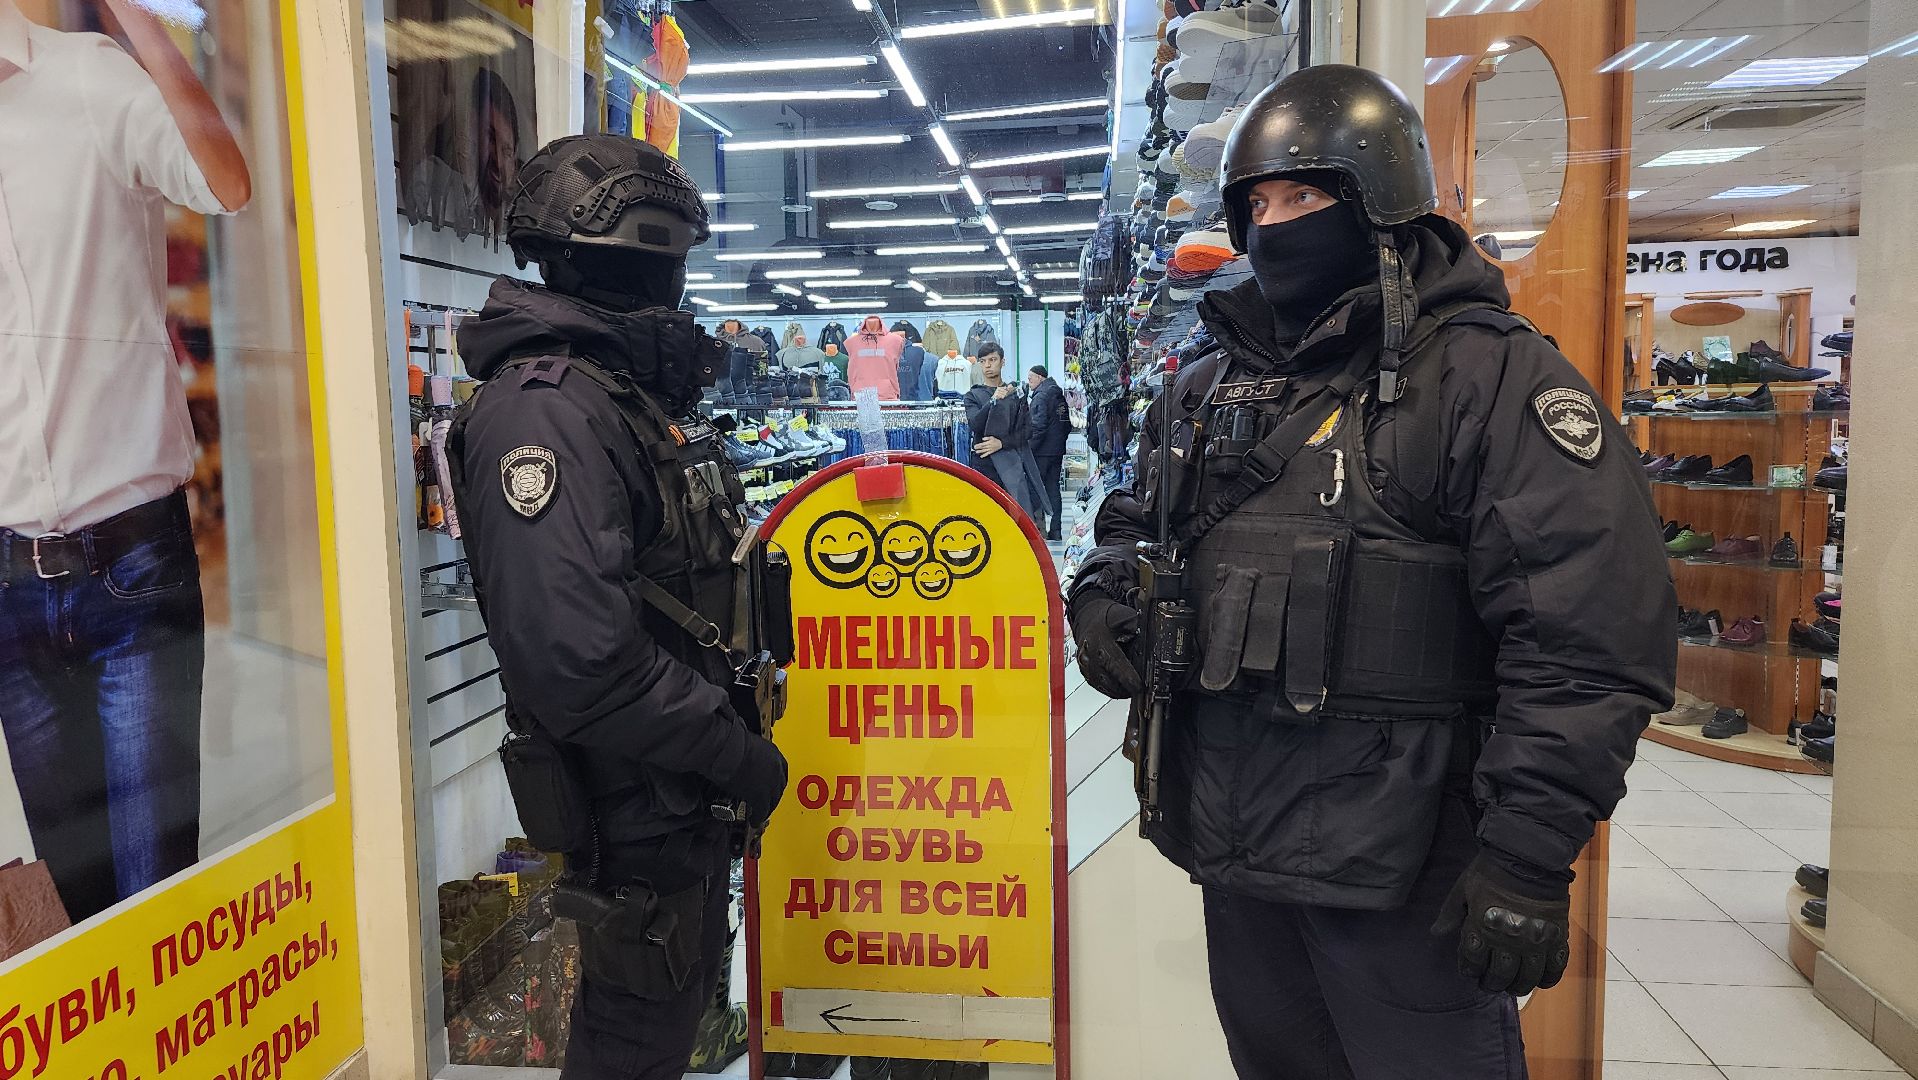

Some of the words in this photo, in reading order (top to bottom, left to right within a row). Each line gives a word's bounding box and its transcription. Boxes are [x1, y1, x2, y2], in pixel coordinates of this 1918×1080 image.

[1700, 246, 1790, 273] года
[1224, 384, 1275, 399] АВГУСТ
[1538, 390, 1592, 408] ПОЛИЦИЯ
[1548, 401, 1590, 416] РОССИЯ
[502, 448, 552, 468] ПОЛИЦИЯ
[519, 502, 540, 514] МВД
[782, 616, 1037, 670] МЕШНЫЕ
[828, 684, 974, 744] ЦЕНЫ
[797, 774, 1013, 818] ОДЕЖДА
[826, 826, 984, 864] ОБУВЬ
[784, 878, 883, 919] ДЛЯ
[900, 874, 1028, 918] ВСЕЙ
[152, 861, 313, 987] посуды,
[824, 929, 990, 970] СЕМЬИ
[155, 921, 338, 1075] матрасы,
[213, 1000, 320, 1080] уары
